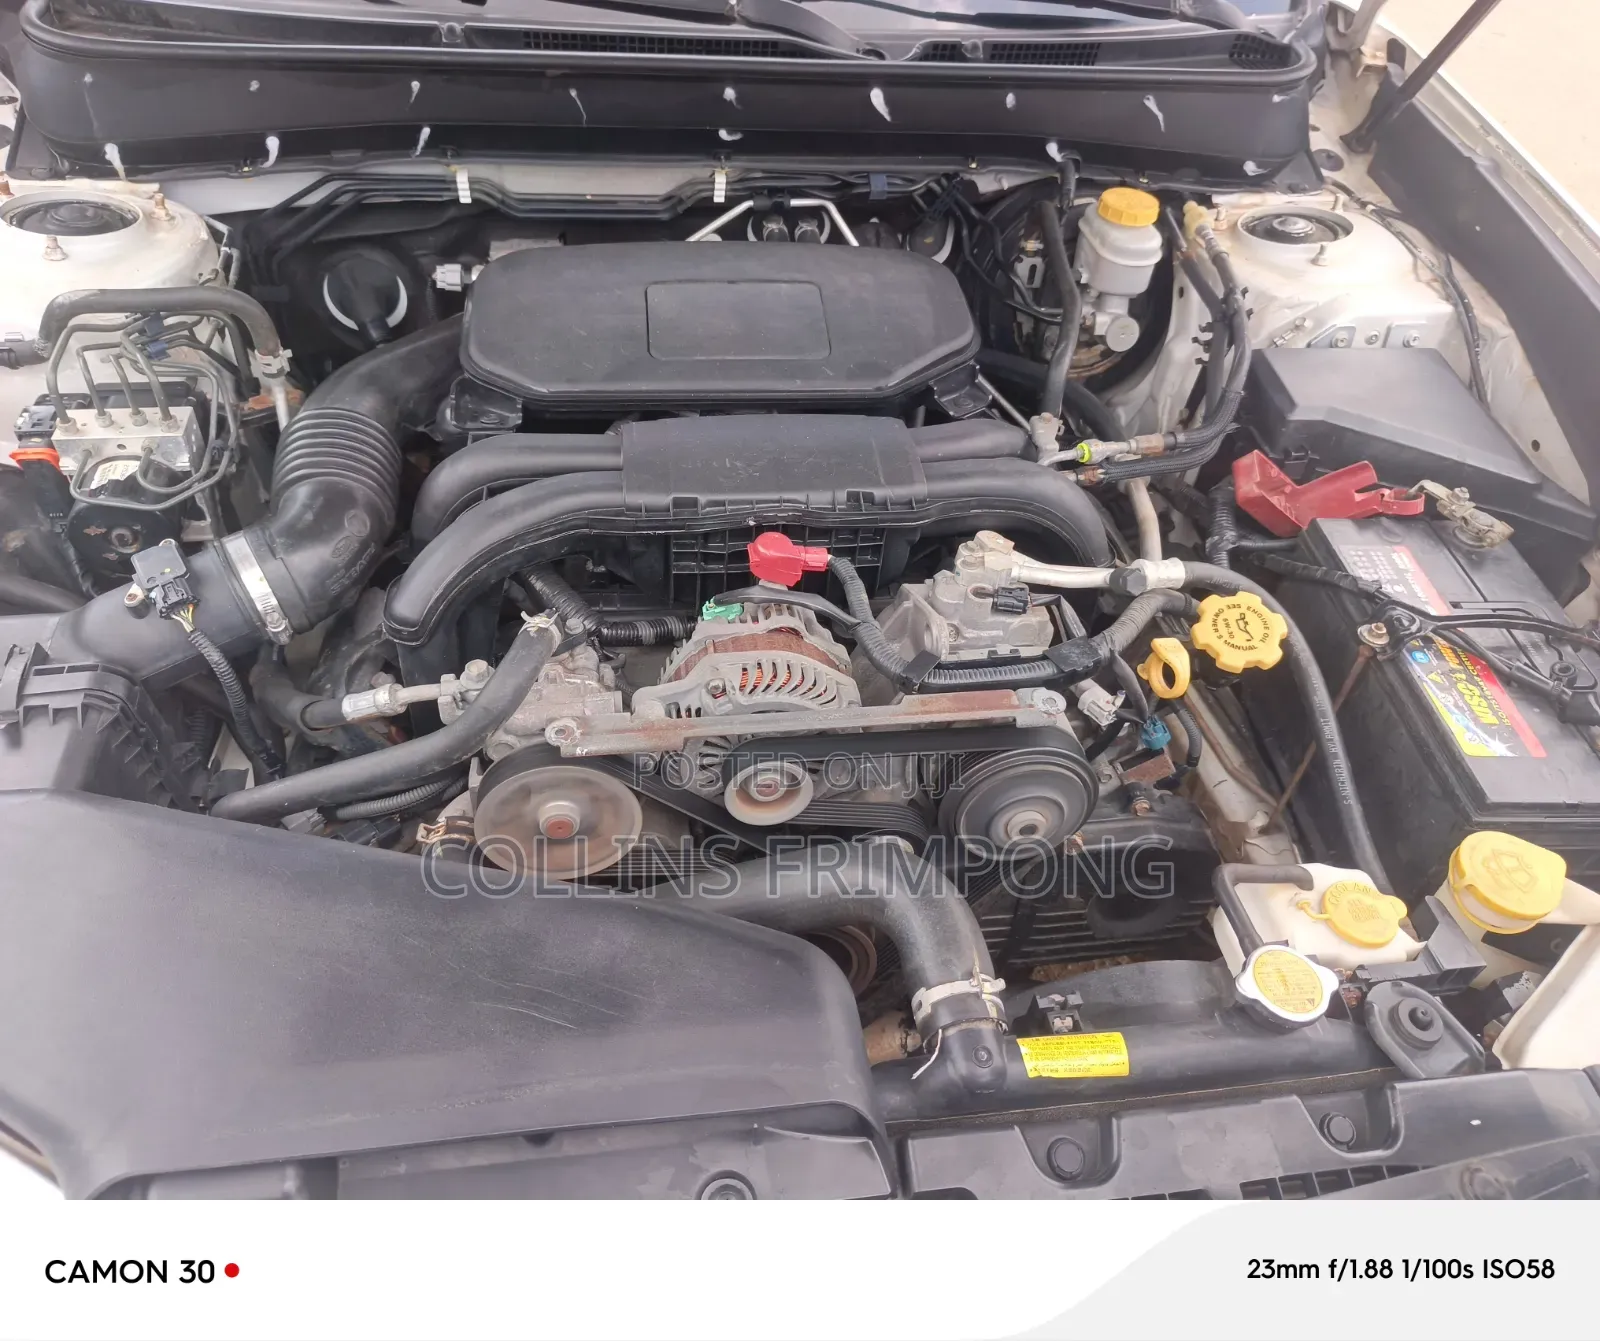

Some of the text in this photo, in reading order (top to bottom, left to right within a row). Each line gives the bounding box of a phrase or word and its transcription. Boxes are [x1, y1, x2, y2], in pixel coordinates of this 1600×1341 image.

[1246, 605, 1270, 644] ENGINE OIL
[1224, 640, 1258, 651] MANUAL
